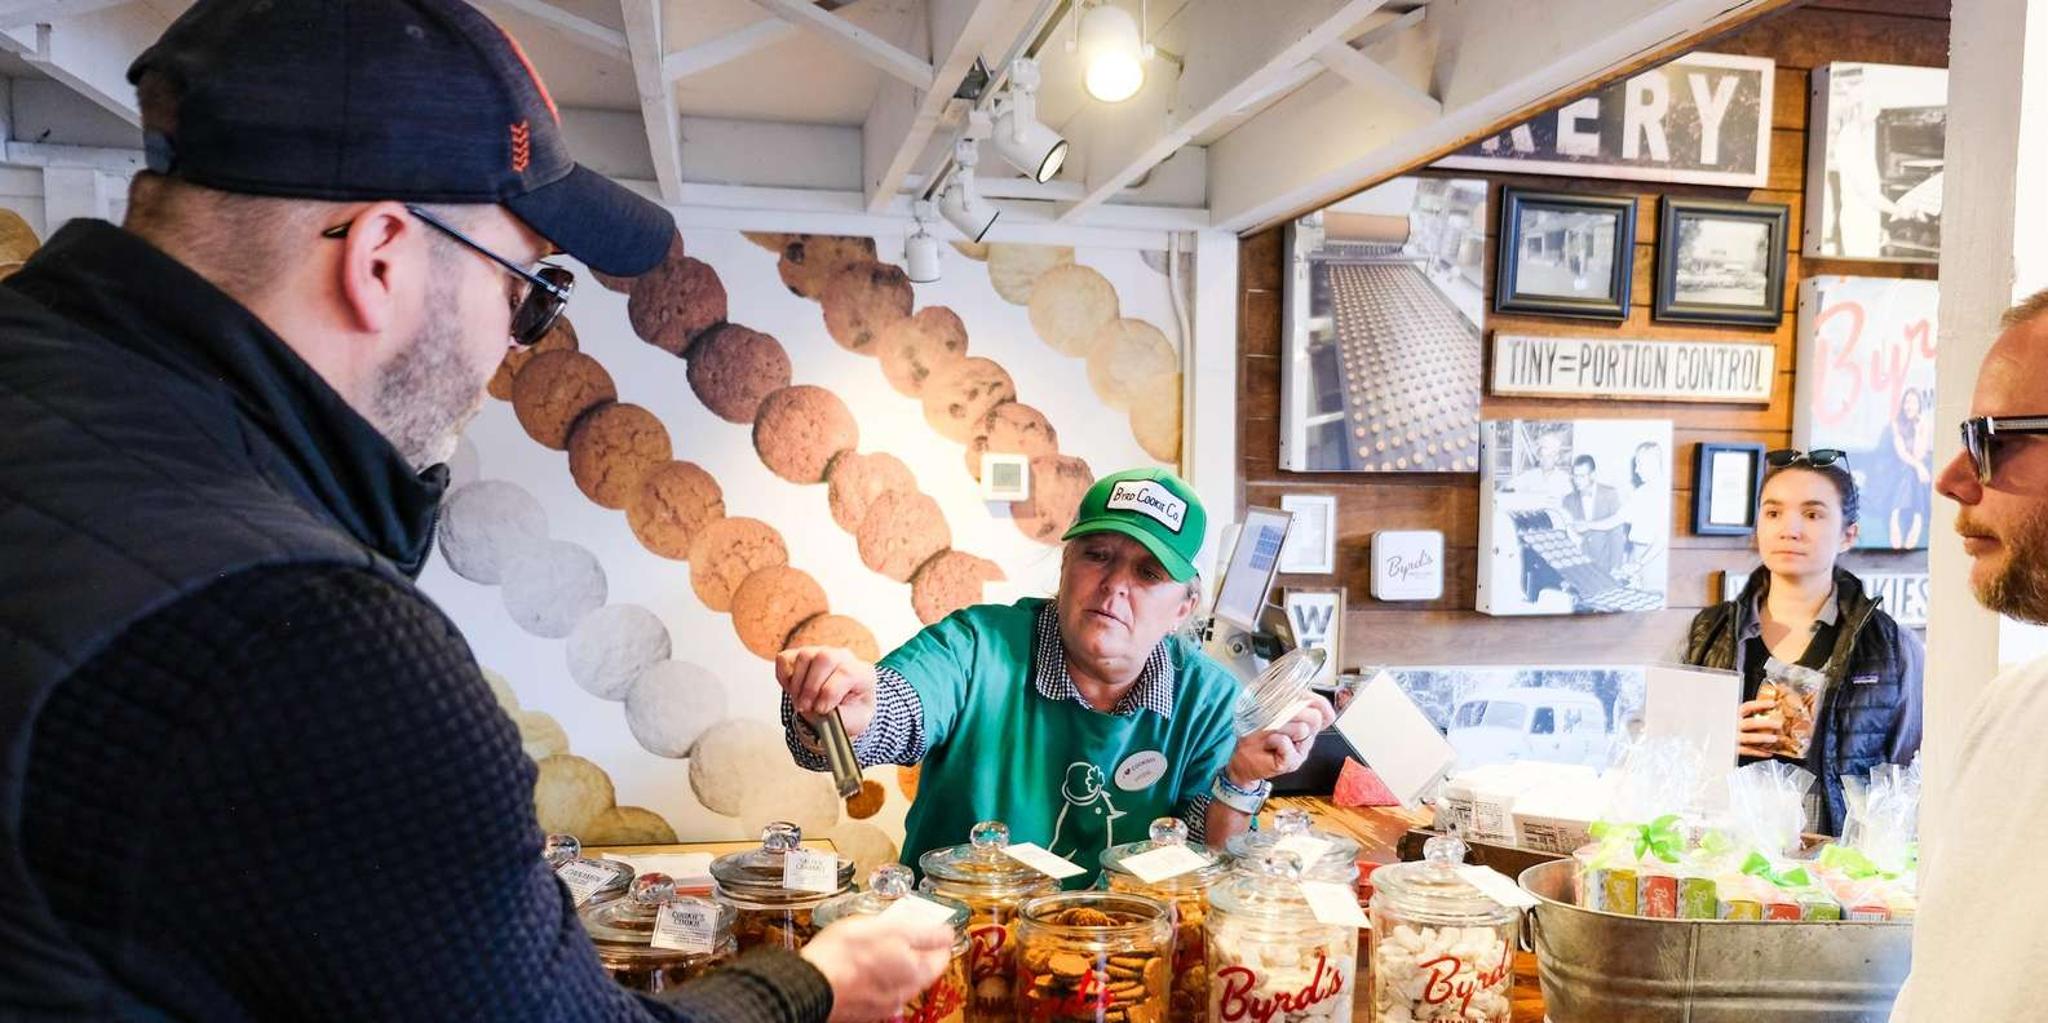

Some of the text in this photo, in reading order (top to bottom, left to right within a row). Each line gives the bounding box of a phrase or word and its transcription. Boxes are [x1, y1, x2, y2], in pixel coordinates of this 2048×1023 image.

[1481, 69, 1739, 165] ERY
[1675, 345, 1765, 393] CONTROL
[1136, 487, 1166, 513] COOKIE
[1217, 953, 1345, 1023] Byrd's
